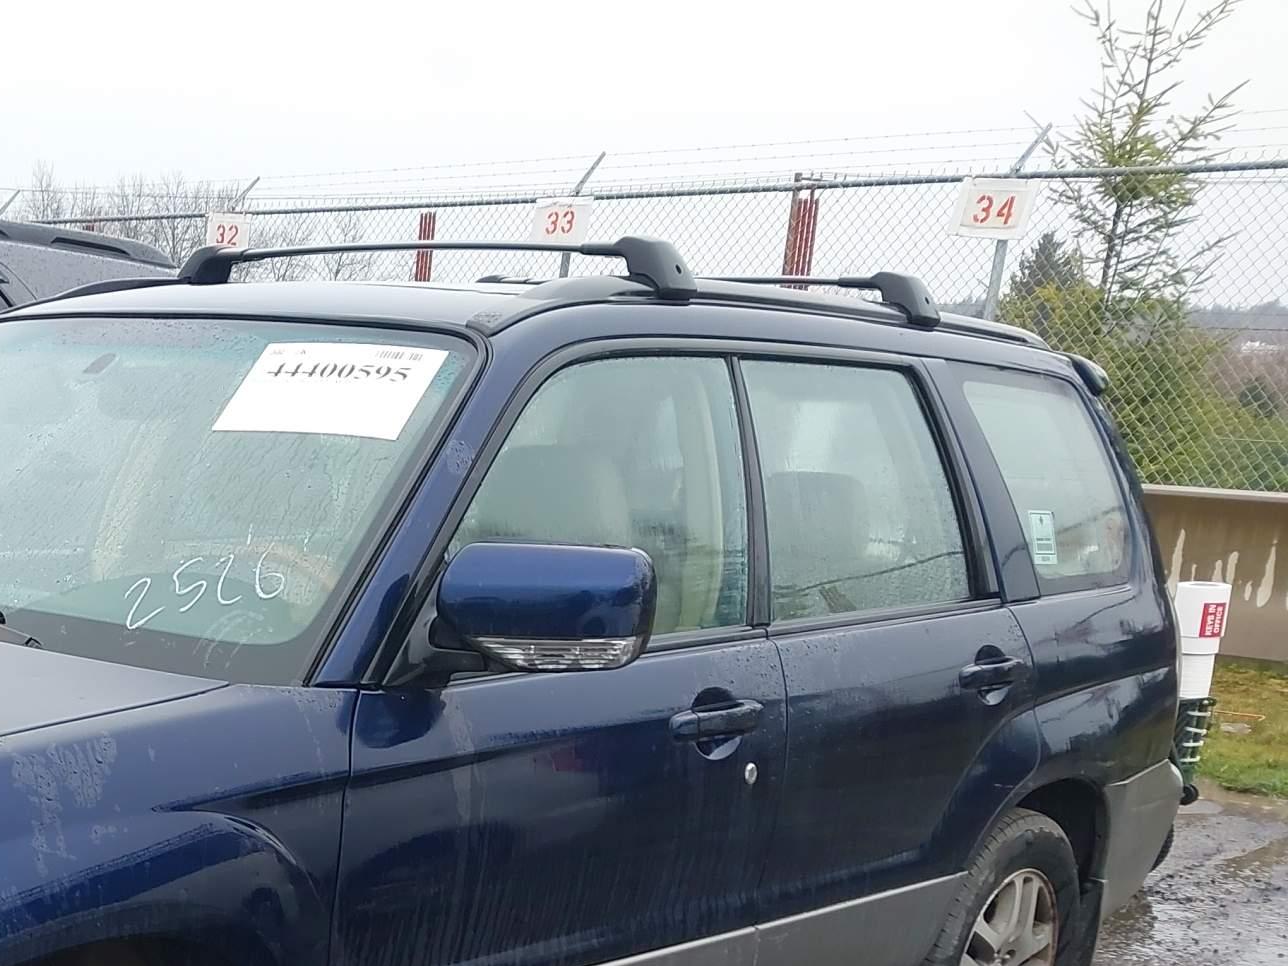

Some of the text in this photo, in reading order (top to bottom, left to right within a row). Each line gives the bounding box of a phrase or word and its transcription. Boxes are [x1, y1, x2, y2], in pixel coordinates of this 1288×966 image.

[972, 194, 1016, 225] 34
[215, 223, 239, 246] 32
[545, 210, 575, 235] 33
[266, 361, 412, 382] 44400595
[123, 541, 286, 630] 2526
